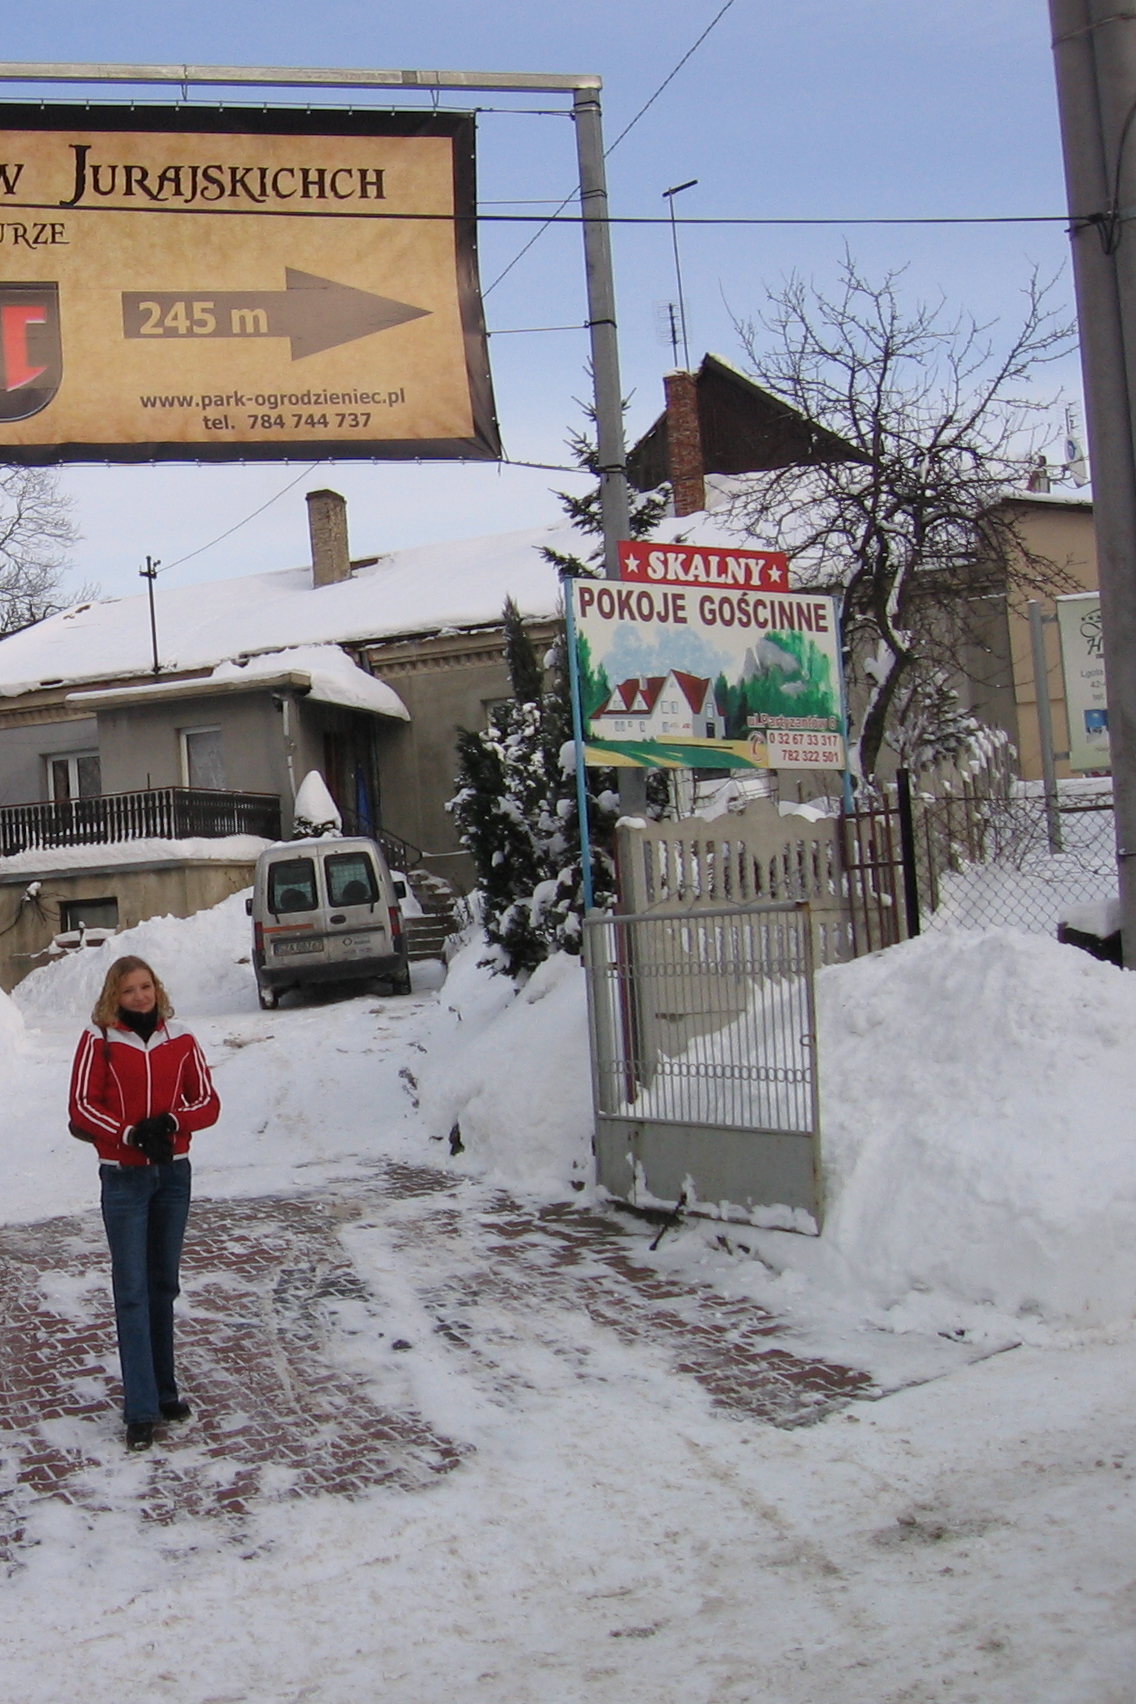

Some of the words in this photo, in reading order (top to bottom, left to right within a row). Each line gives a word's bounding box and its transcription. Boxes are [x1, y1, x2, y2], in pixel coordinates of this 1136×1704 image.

[138, 301, 216, 335] 245
[230, 307, 269, 334] m
[140, 388, 406, 410] www.park-ogrodzieniec.pl
[202, 415, 235, 430] tel.
[247, 414, 285, 429] 784
[292, 413, 329, 428] 744
[334, 412, 372, 428] 737
[647, 551, 765, 586] SKALNY
[578, 586, 688, 624] POKOJE
[699, 592, 829, 632] GOŚCINNE
[769, 732, 776, 744] 0
[778, 733, 790, 744] 32
[793, 733, 804, 745] 67
[807, 735, 819, 746] 33
[821, 735, 838, 747] 317
[782, 749, 800, 761] 782
[802, 750, 820, 762] 322
